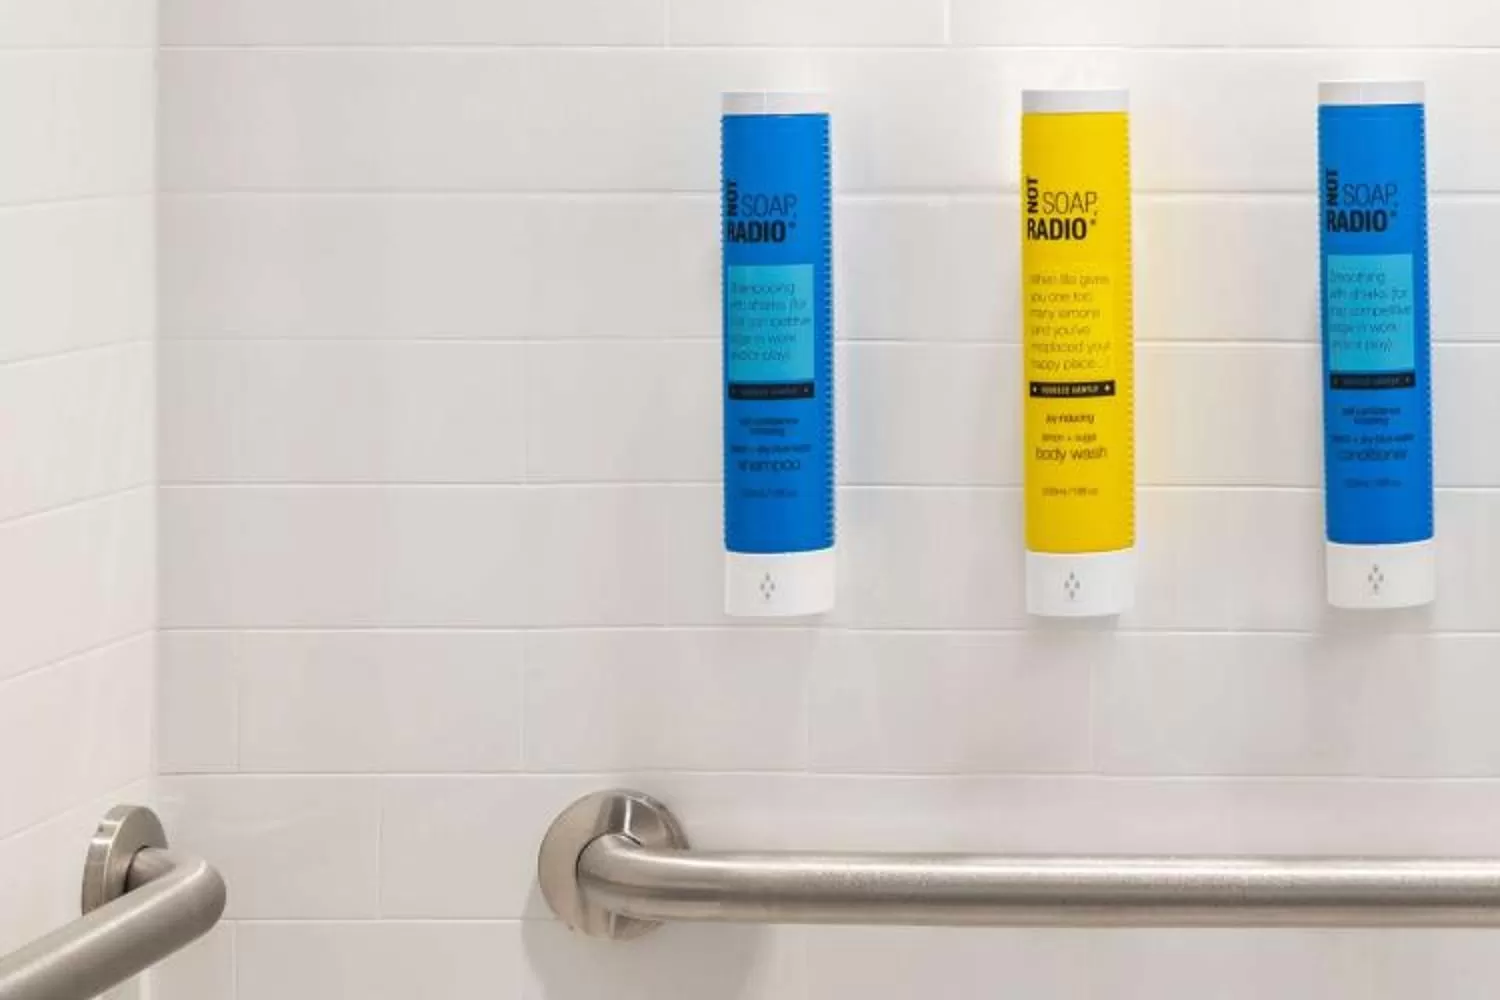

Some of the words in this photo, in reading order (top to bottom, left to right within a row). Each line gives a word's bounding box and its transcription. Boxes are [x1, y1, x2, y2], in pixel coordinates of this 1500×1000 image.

[1026, 178, 1040, 215] NOT
[1034, 447, 1066, 464] body
[1071, 447, 1108, 461] wash
